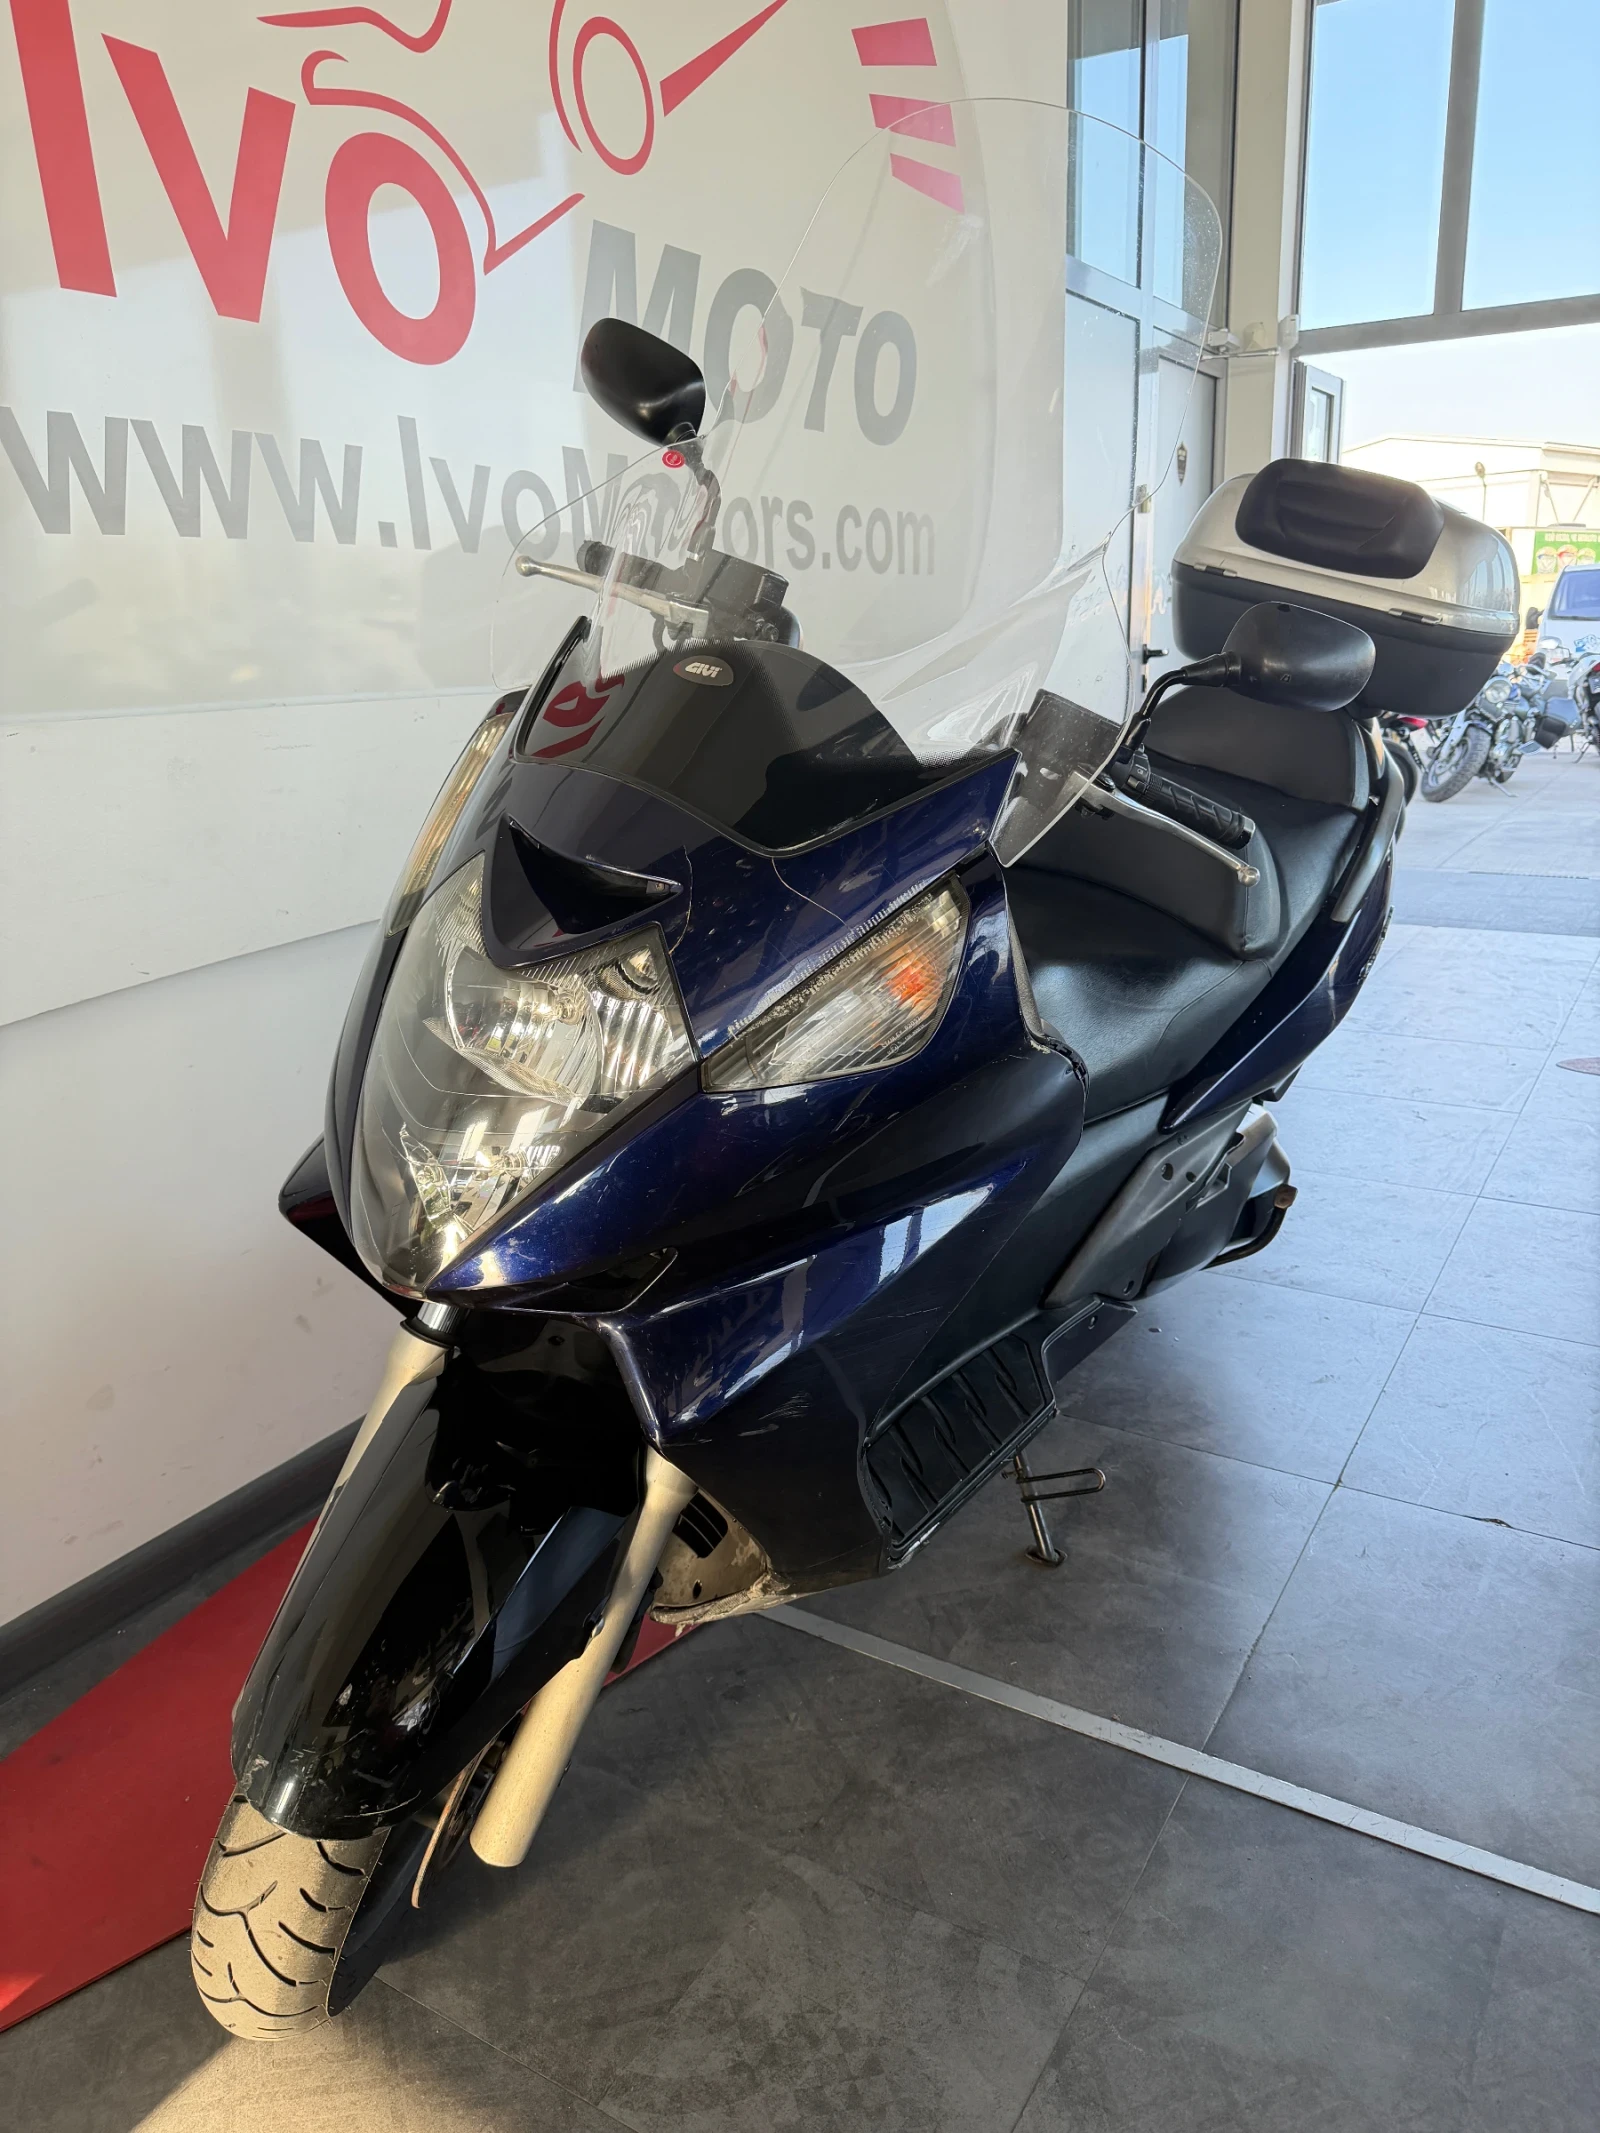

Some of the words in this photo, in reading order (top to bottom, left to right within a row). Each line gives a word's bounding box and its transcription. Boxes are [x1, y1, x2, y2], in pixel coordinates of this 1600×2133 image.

[573, 219, 918, 446] MOTO
[0, 405, 935, 576] www.IvoMors.com
[685, 662, 720, 678] GIVI
